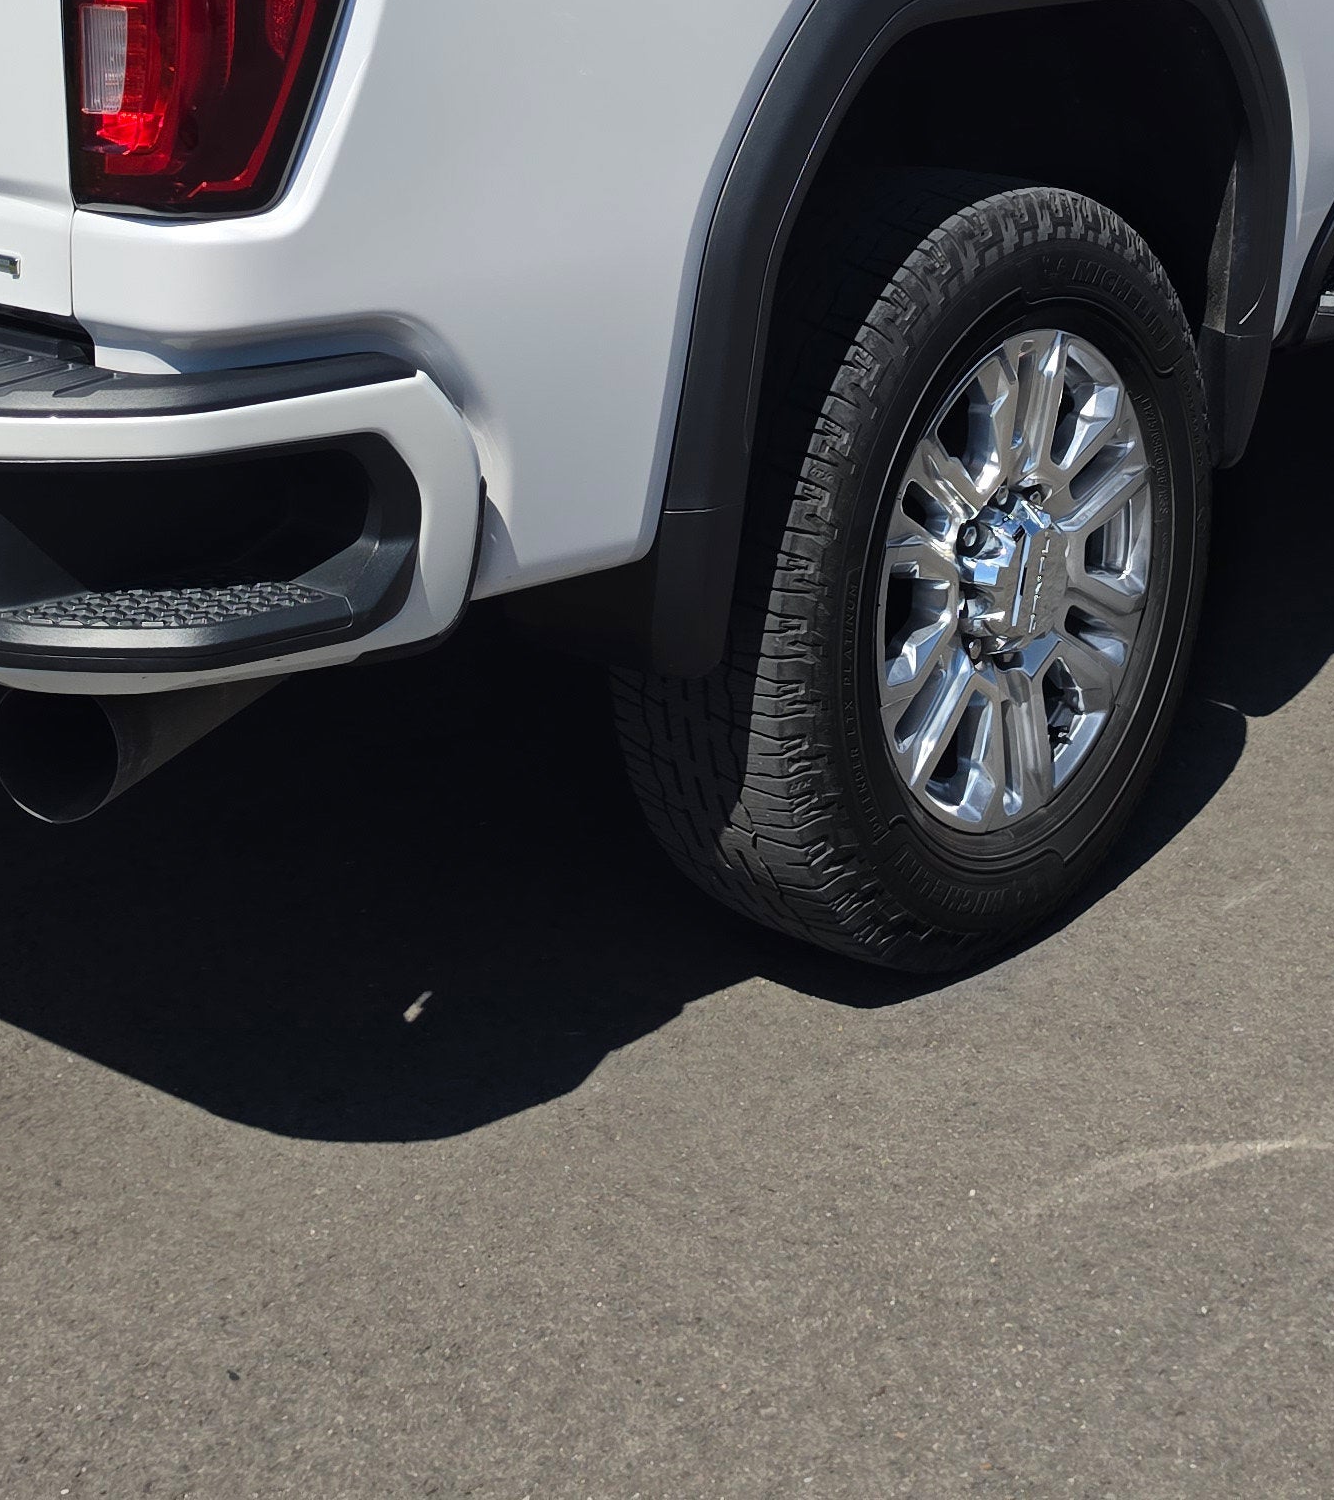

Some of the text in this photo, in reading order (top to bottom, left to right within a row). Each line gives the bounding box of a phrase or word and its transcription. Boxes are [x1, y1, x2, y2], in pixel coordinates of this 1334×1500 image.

[1071, 259, 1177, 352] MICHELIN
[842, 585, 859, 687] PLATINUM
[843, 700, 857, 737] LTX
[894, 850, 1011, 915] MICHELIN
